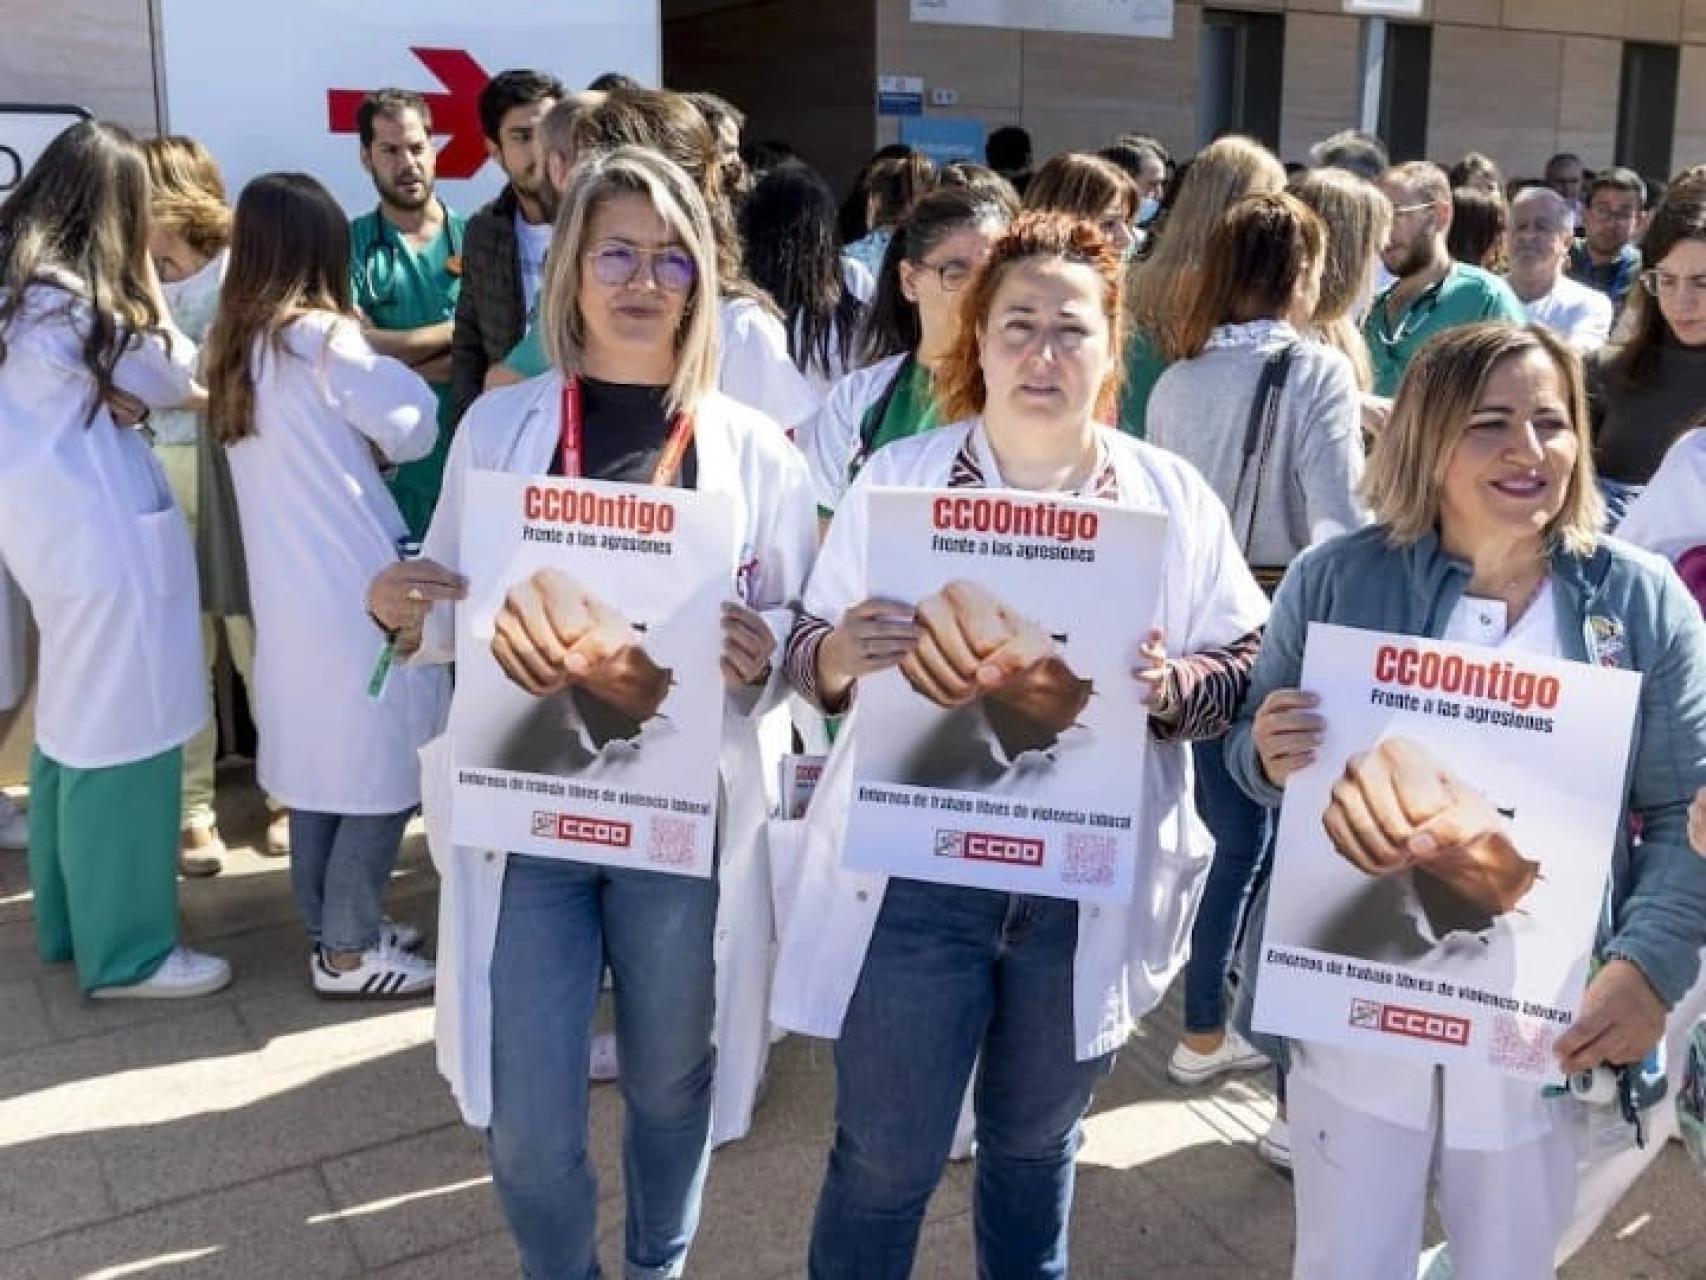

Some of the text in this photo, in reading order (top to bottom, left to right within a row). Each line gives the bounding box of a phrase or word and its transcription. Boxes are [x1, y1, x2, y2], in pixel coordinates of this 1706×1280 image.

[524, 485, 675, 534] CCOOntigo
[932, 496, 1099, 542] CCOOntigo
[522, 525, 671, 556] Frente a las agresiones
[932, 535, 1096, 563] Frente a las agresiones
[1375, 646, 1560, 708] CCOOntigo
[1371, 687, 1555, 733] Frente a las agresiones
[562, 818, 628, 843] CCOO
[967, 836, 1041, 863] CCOO
[1266, 948, 1323, 973] Entornos
[1326, 959, 1343, 975] de
[1437, 981, 1455, 996] de
[1386, 1010, 1464, 1040] CCOO
